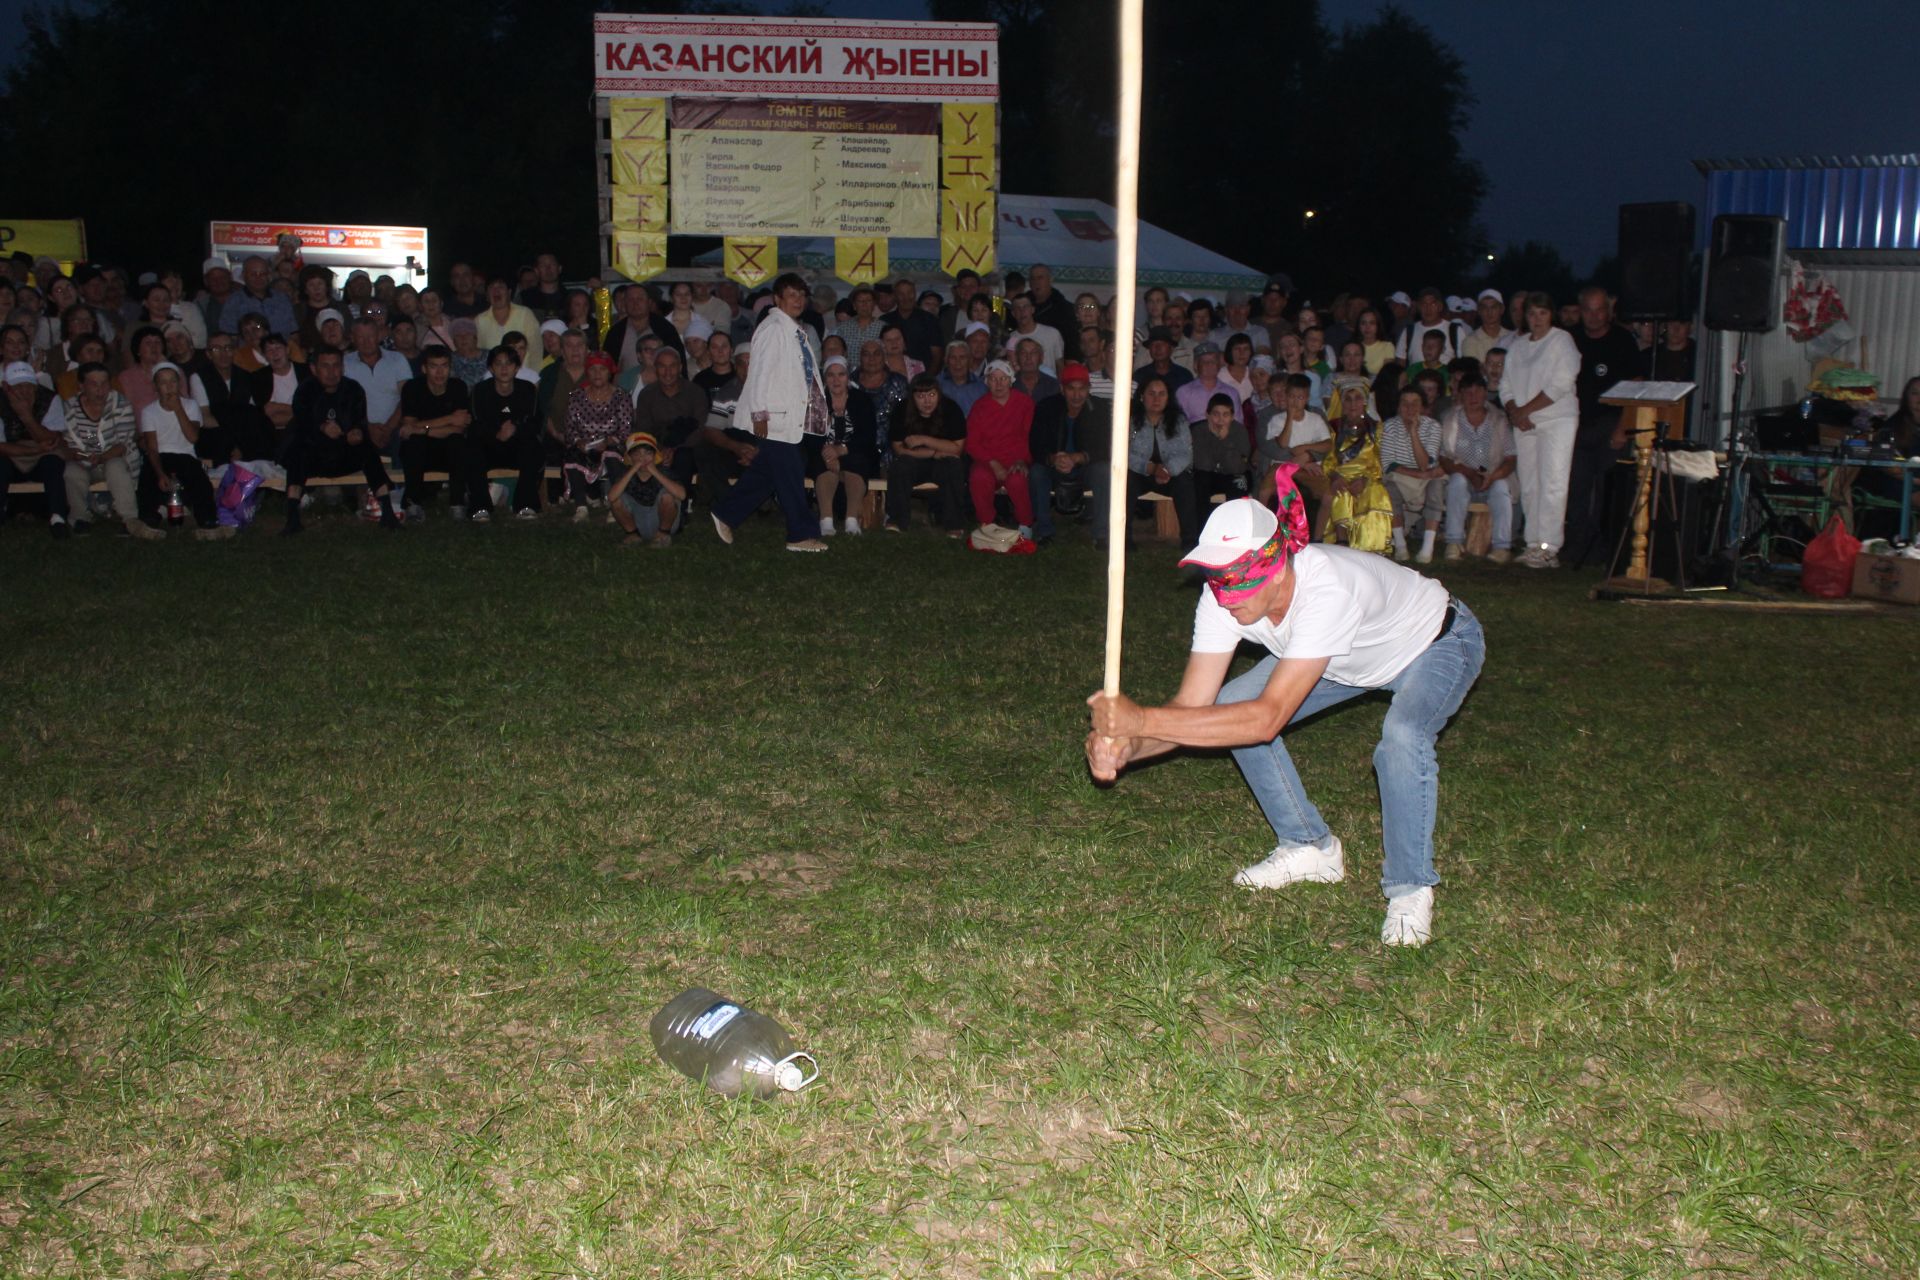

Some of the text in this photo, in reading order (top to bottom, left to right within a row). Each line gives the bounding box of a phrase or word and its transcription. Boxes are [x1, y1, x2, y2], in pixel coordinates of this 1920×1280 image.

[605, 39, 823, 75] КАЗАНСКИЙ
[818, 105, 847, 118] ИЛЕ
[816, 121, 864, 130] РОДОВЫЕ
[867, 122, 897, 131] ЗНАКИ
[235, 226, 270, 234] ХОТ-ДОГ
